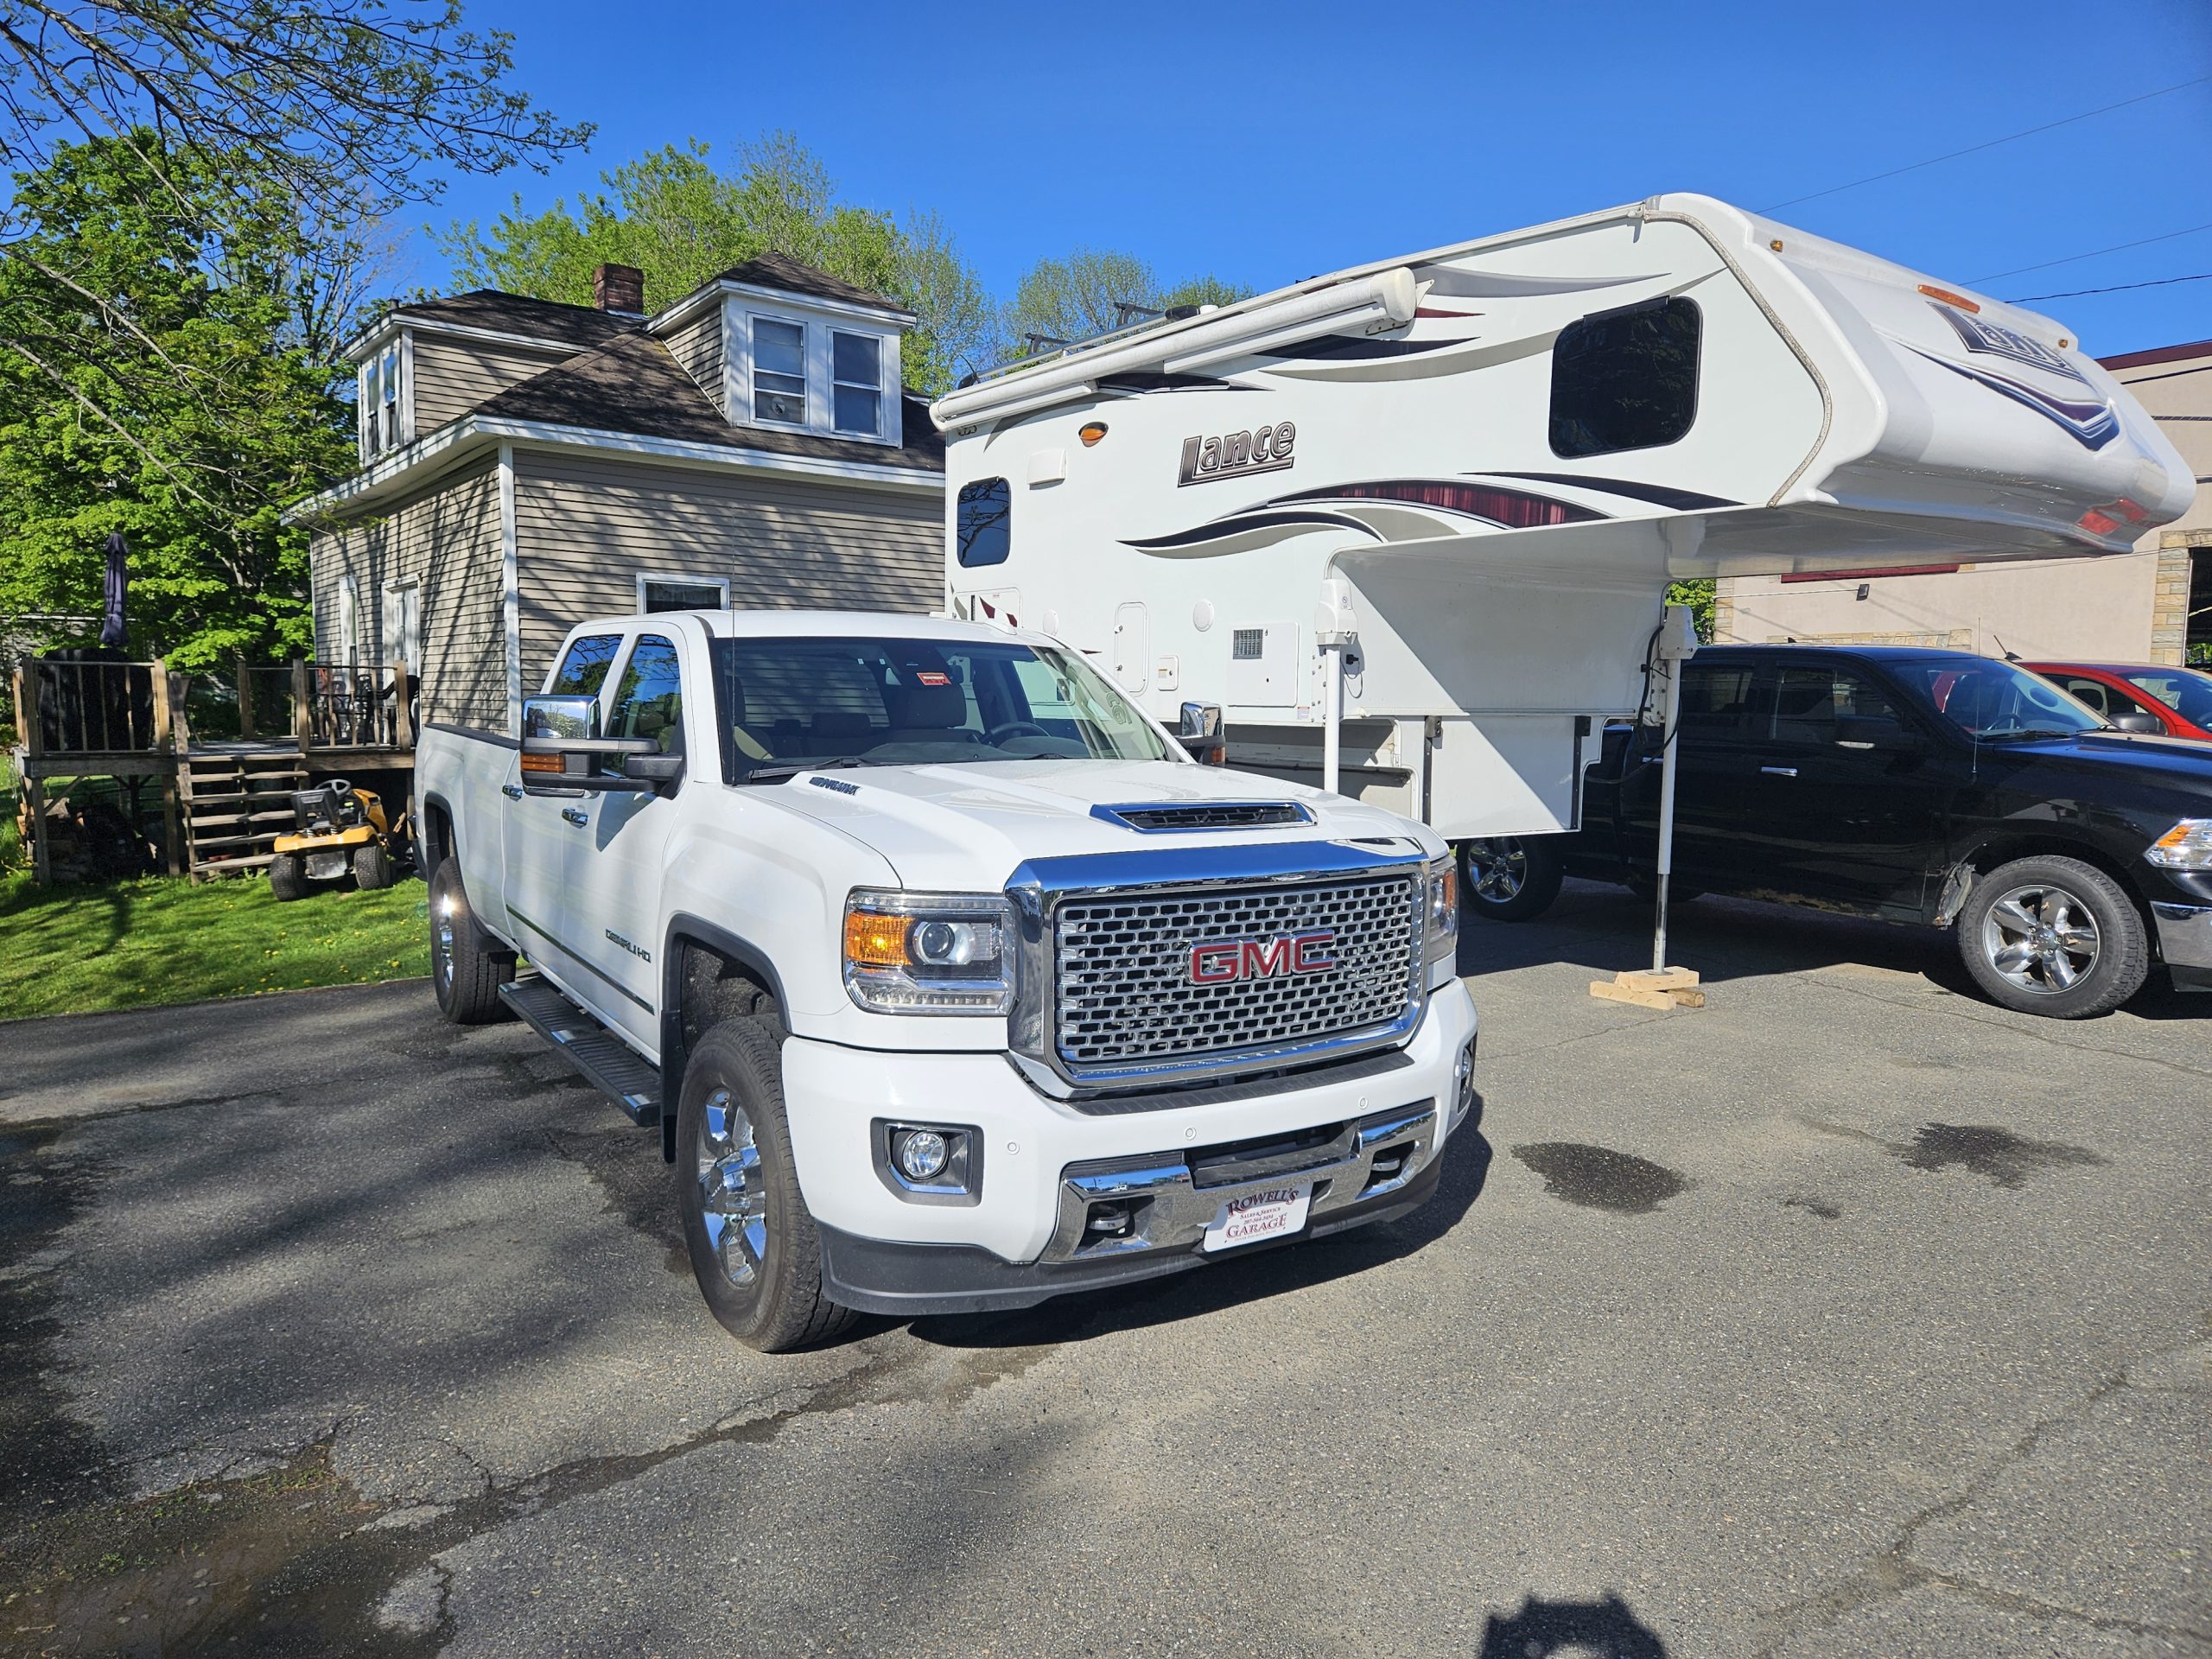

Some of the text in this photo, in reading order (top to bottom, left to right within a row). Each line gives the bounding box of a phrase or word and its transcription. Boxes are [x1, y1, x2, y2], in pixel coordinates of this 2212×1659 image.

[1178, 422, 1295, 488] Lance
[1190, 929, 1334, 985] GMC
[1225, 1188, 1299, 1217] ROWELL'S
[1226, 1212, 1287, 1238] GARAGE
